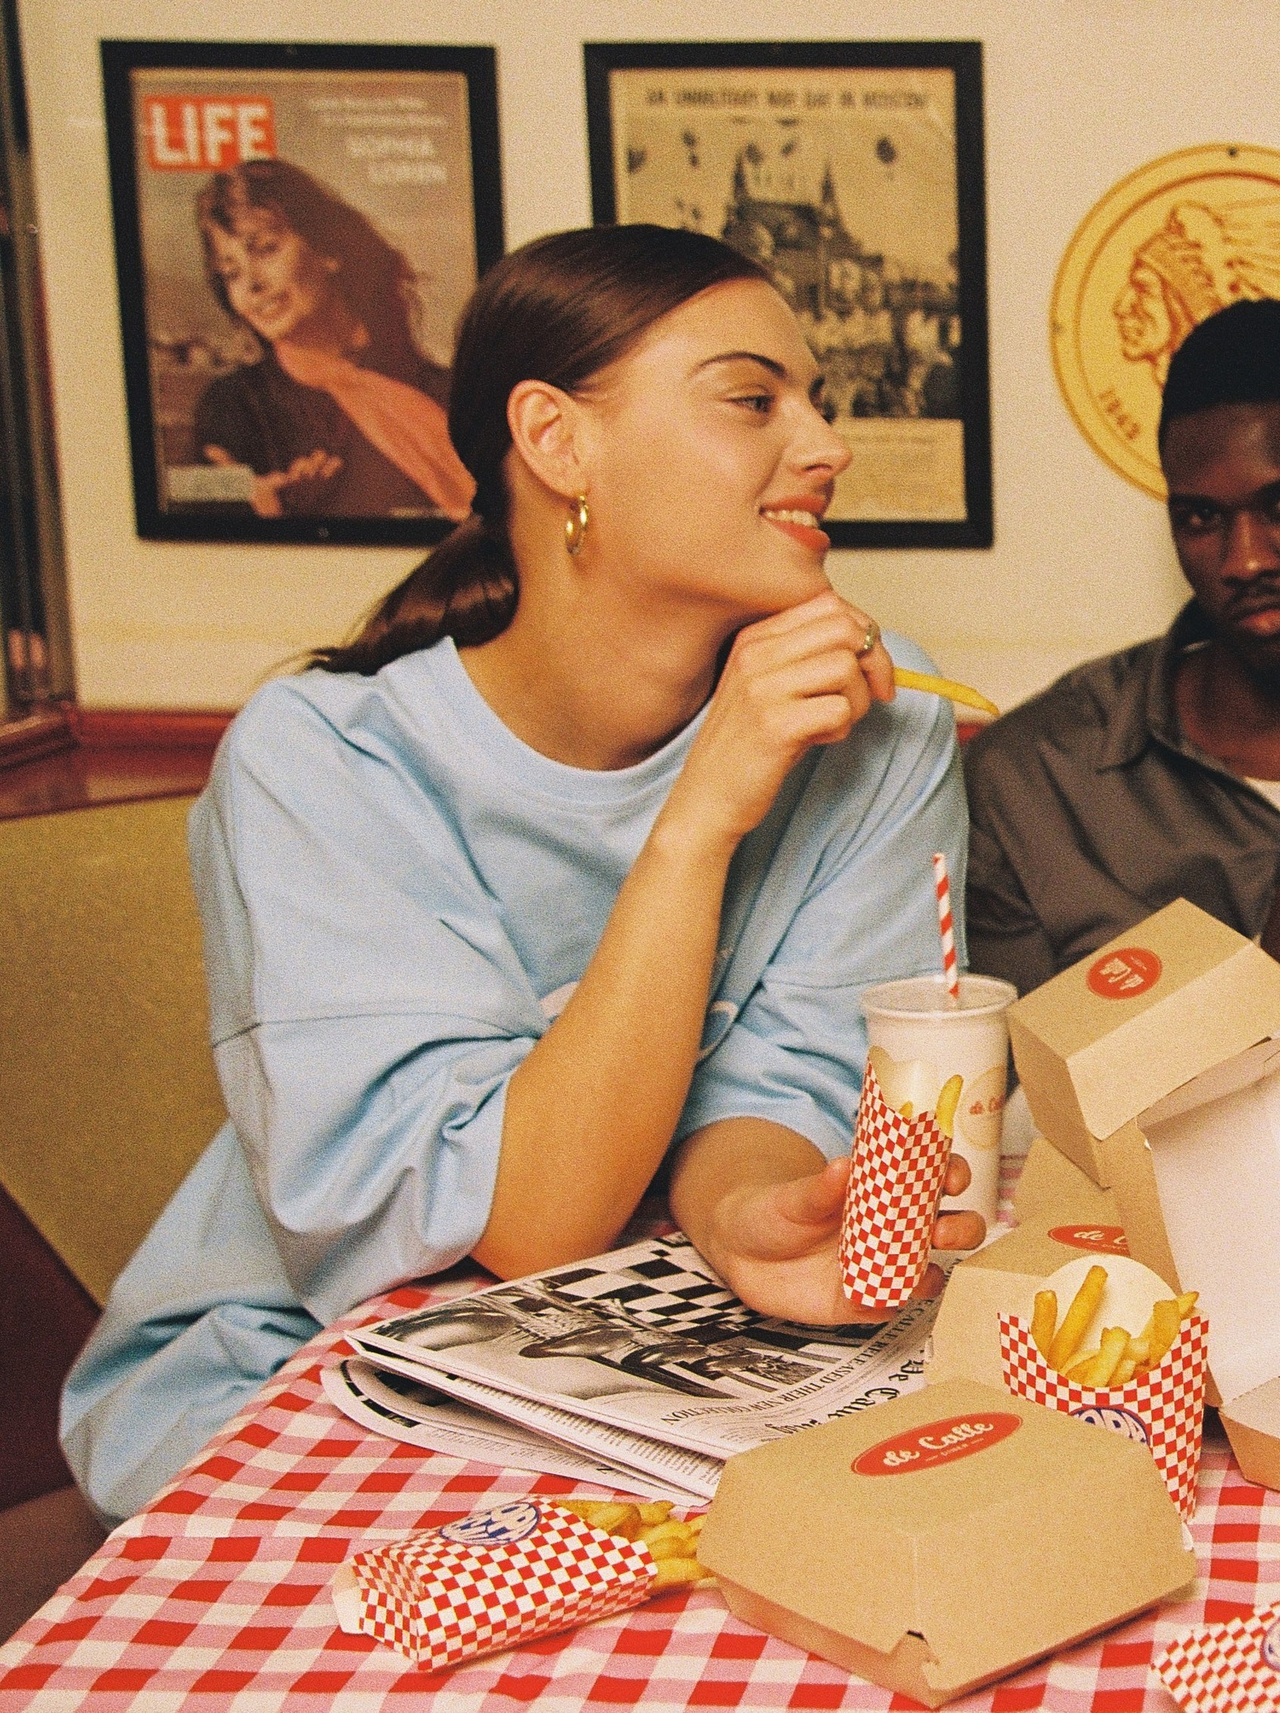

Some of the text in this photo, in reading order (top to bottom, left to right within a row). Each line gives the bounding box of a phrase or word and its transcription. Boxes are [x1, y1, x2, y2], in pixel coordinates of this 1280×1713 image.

[151, 101, 271, 165] LIFE
[819, 1339, 889, 1385] RELEASED
[781, 1382, 826, 1402] THEIR
[881, 1420, 995, 1469] de Calle
